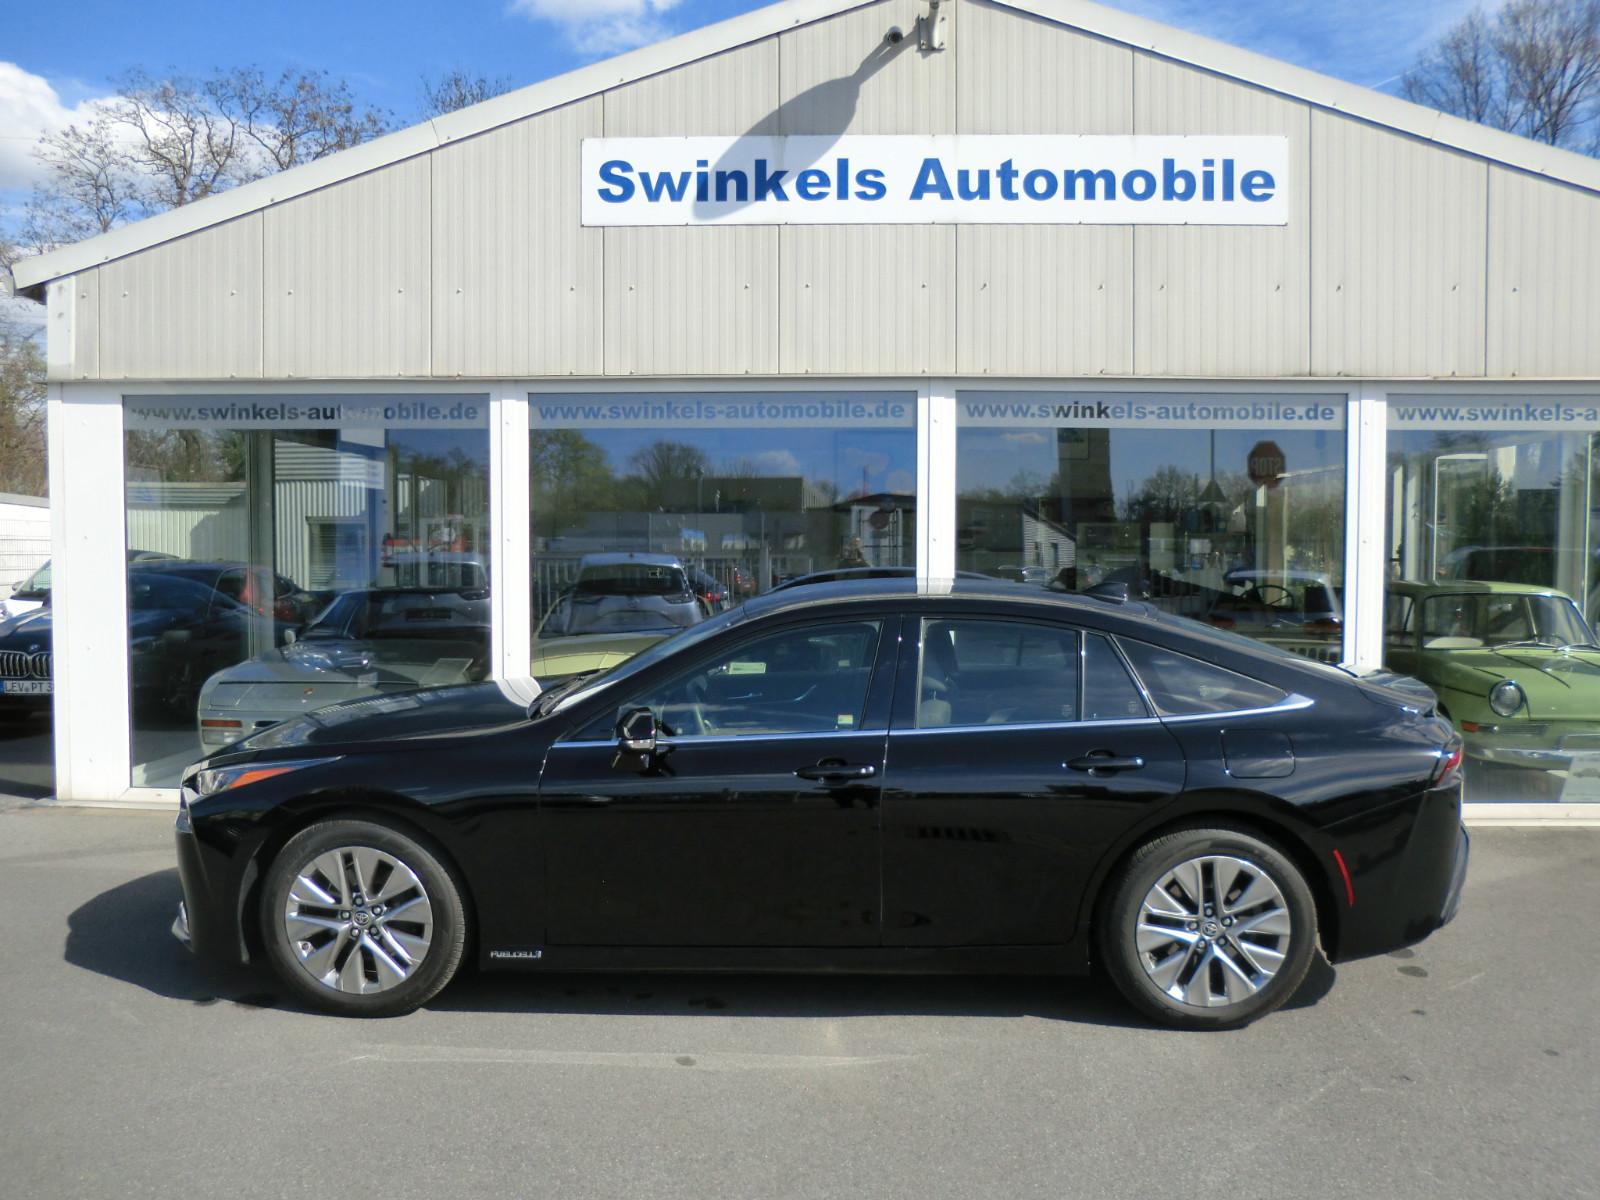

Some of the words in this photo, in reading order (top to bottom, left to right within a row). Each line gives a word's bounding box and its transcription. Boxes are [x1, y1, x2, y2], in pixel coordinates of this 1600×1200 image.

[598, 158, 887, 204] Swinkels
[909, 157, 1276, 203] Automobile
[131, 402, 479, 421] www.swinkels-autobile.de
[538, 400, 905, 420] www.swinkels-automobile.de
[965, 400, 1336, 421] www.swinkels-automobile.de
[1395, 403, 1598, 422] www.swinkels-a
